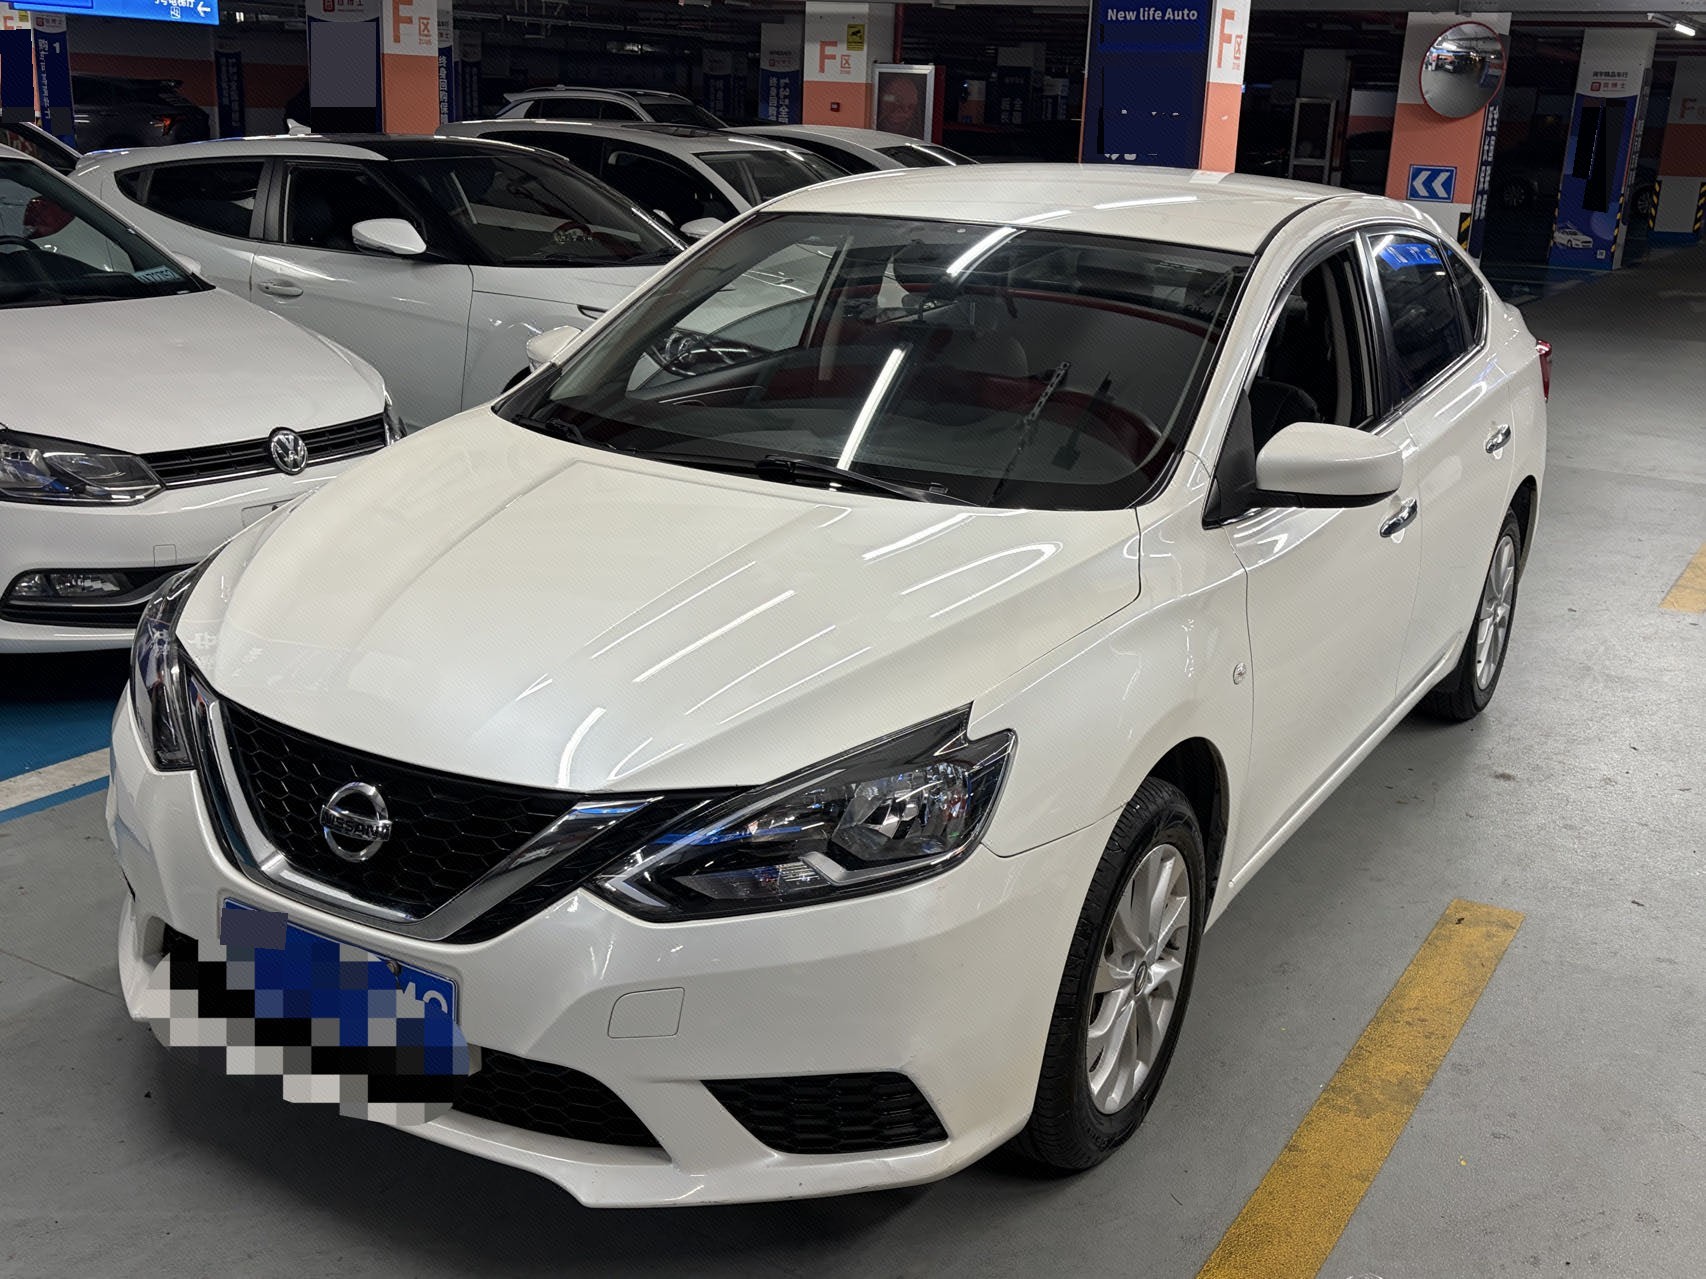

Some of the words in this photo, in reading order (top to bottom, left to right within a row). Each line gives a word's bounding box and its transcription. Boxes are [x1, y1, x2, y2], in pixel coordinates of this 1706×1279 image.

[1107, 8, 1137, 21] New
[1139, 7, 1162, 20] life
[1164, 7, 1198, 20] Auto
[322, 810, 391, 840] NISSAN
